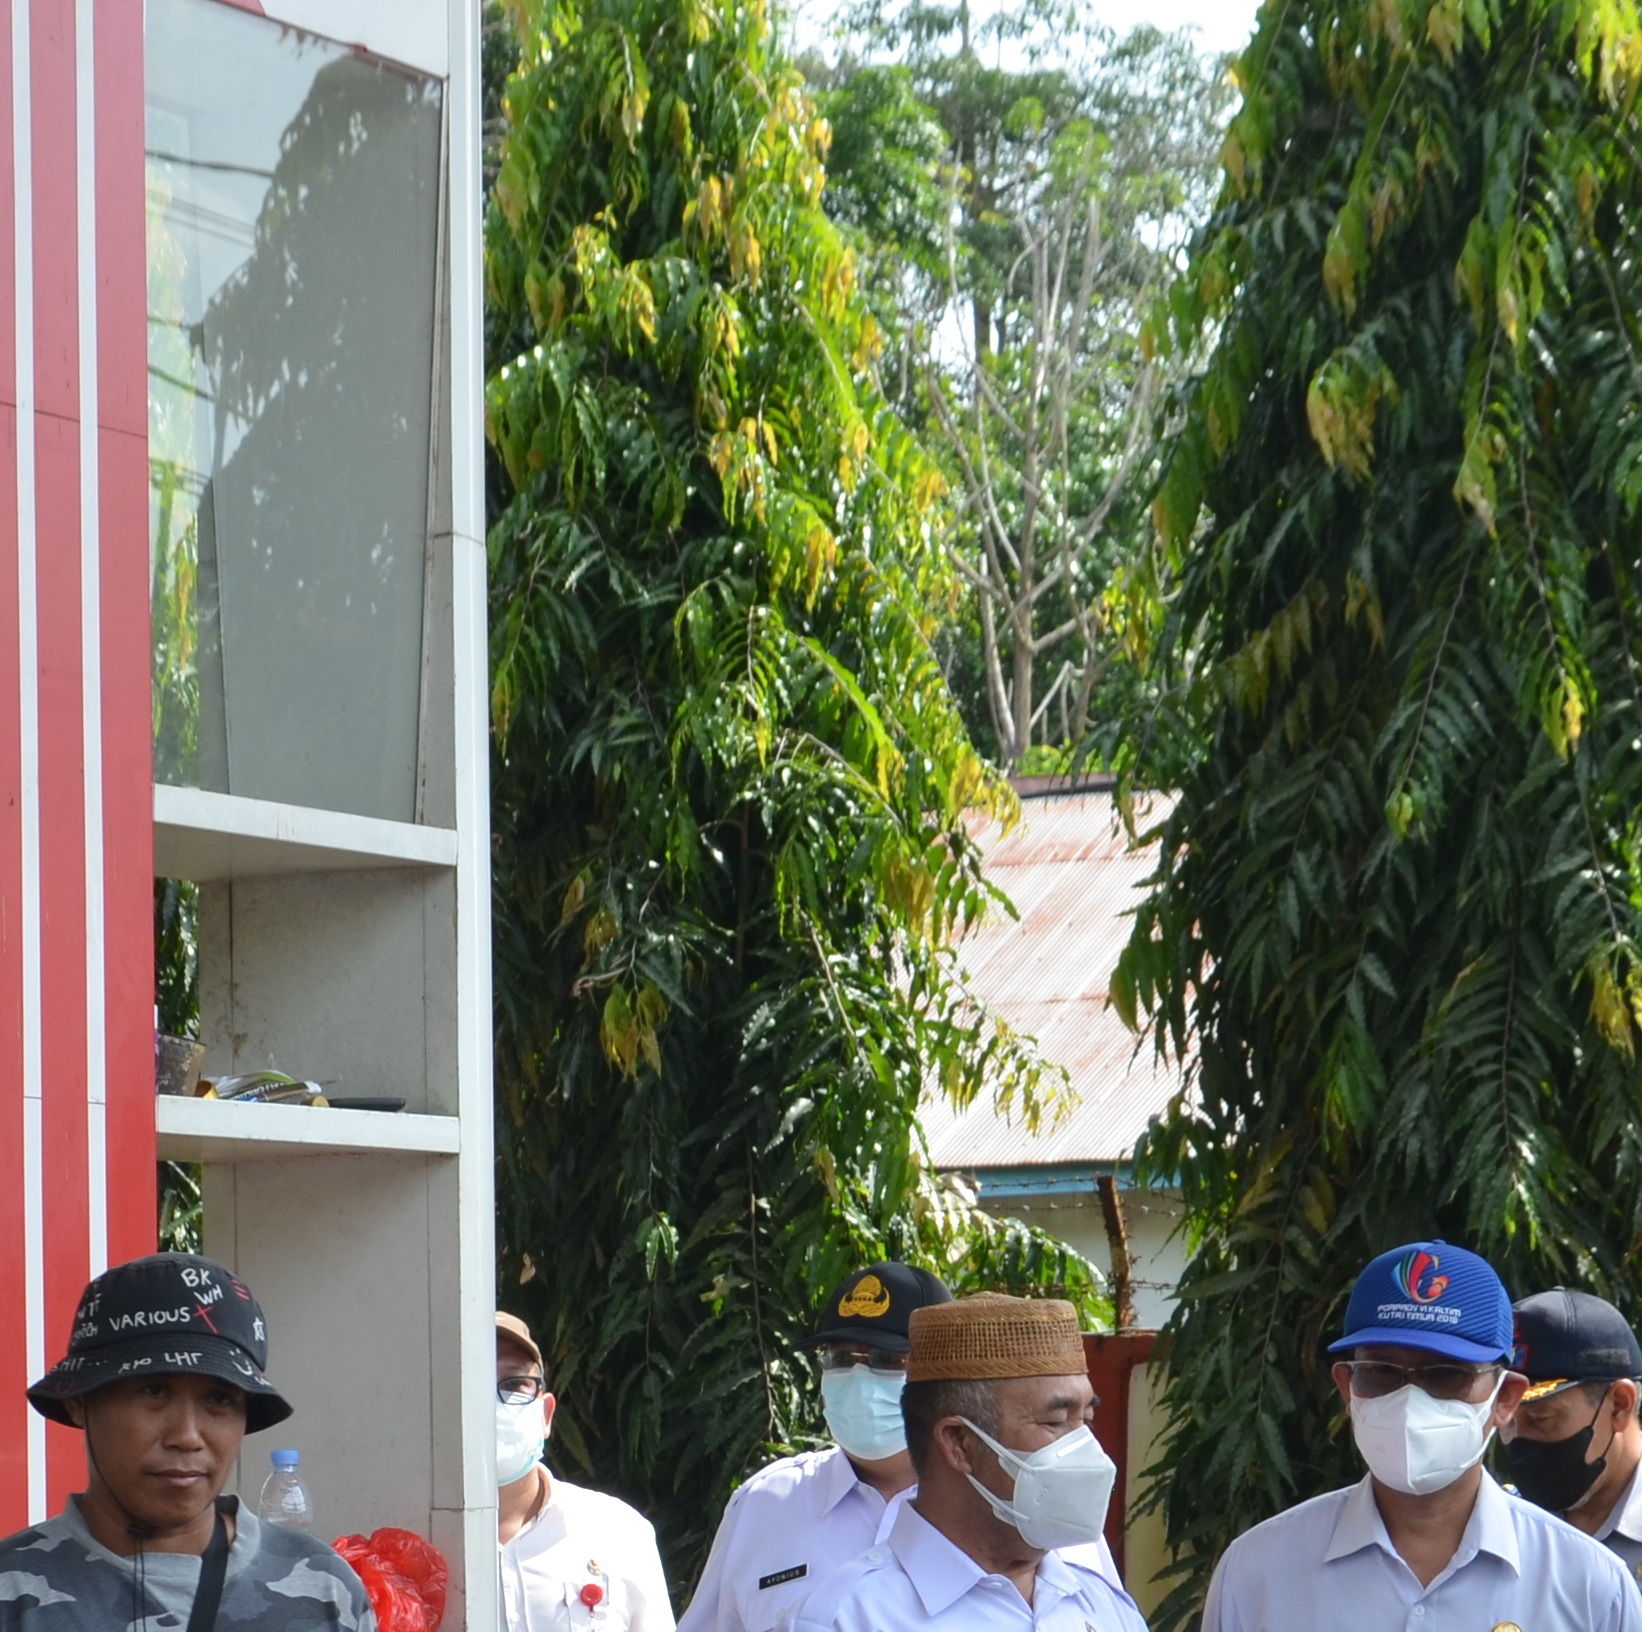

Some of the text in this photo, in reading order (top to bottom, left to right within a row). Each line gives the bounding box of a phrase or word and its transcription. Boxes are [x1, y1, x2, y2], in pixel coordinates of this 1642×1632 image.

[181, 1268, 212, 1287] BK
[194, 1284, 223, 1305] WH
[109, 1306, 191, 1331] VARIOUS
